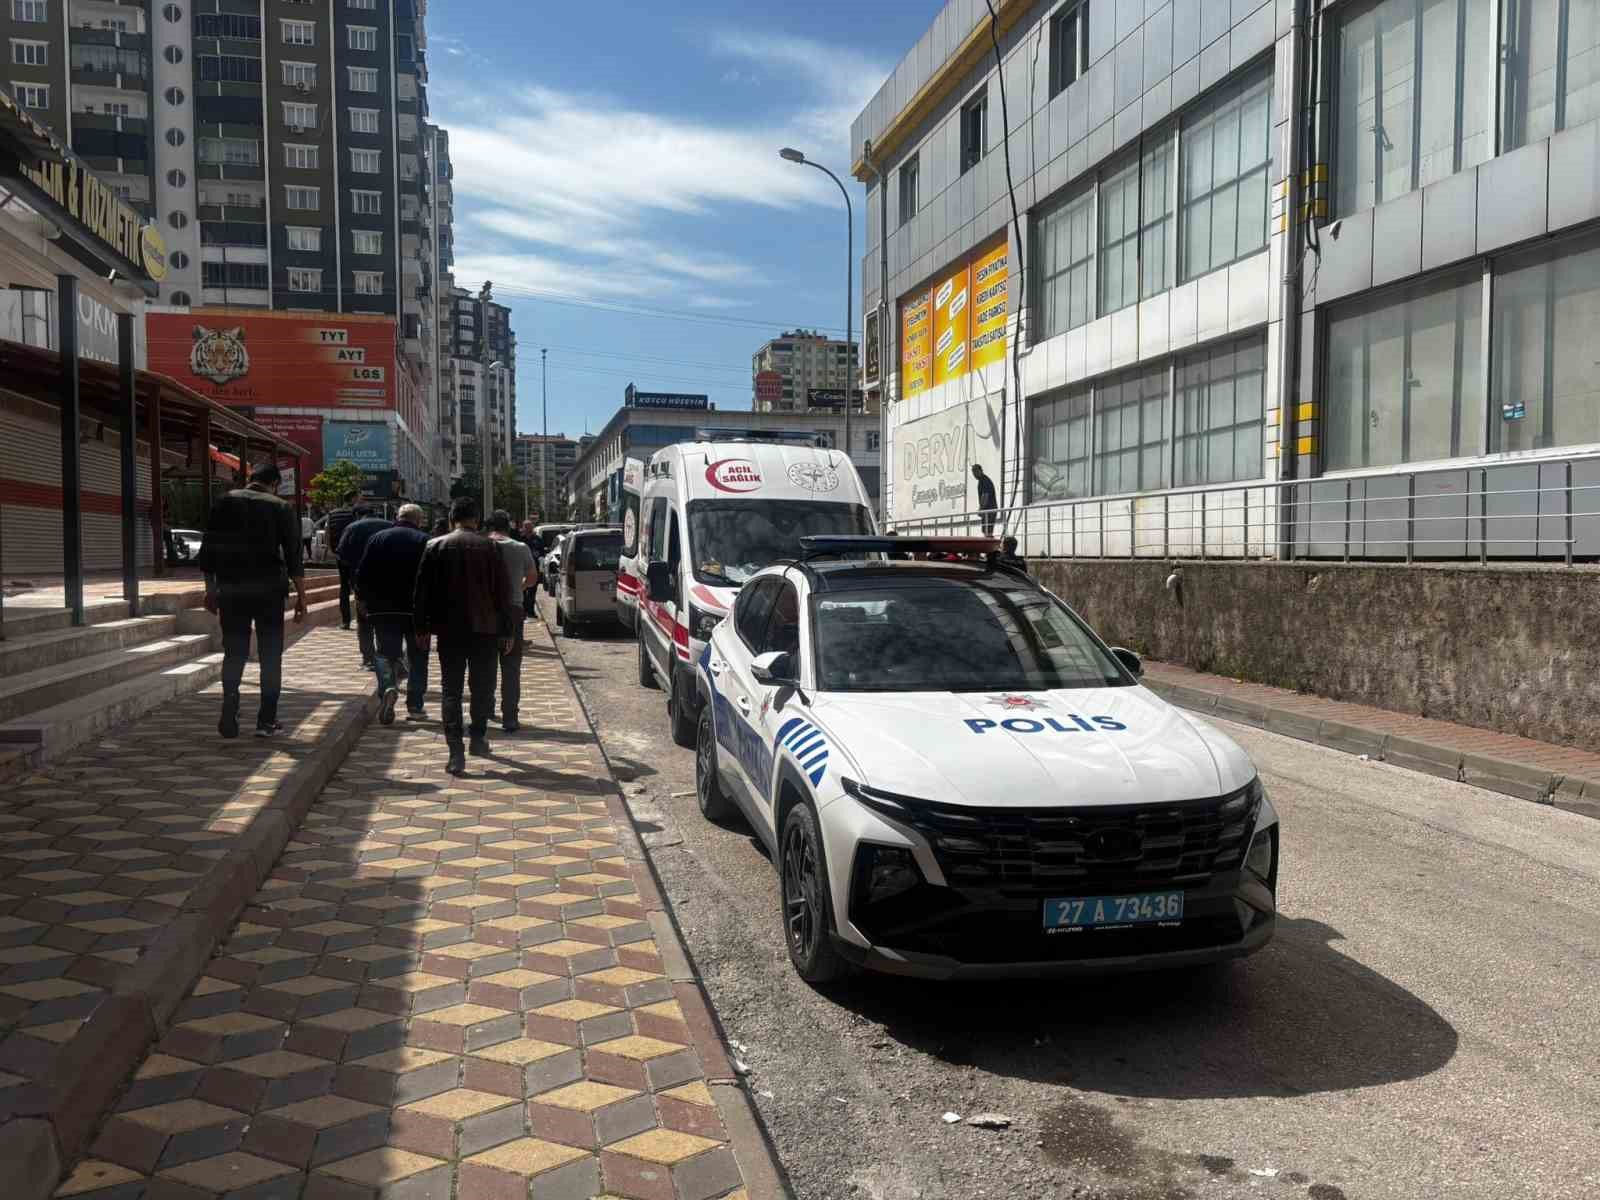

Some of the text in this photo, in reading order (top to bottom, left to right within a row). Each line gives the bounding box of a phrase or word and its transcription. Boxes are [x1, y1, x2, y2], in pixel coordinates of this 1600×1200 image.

[319, 330, 345, 342] TYT
[338, 349, 363, 361] AYT
[353, 368, 381, 380] LGS
[904, 424, 977, 481] DERYA
[728, 465, 753, 474] ACİL
[722, 473, 762, 484] SAĞLIK
[963, 713, 1128, 735] POLİS
[1057, 894, 1180, 925] 27 A 73436
